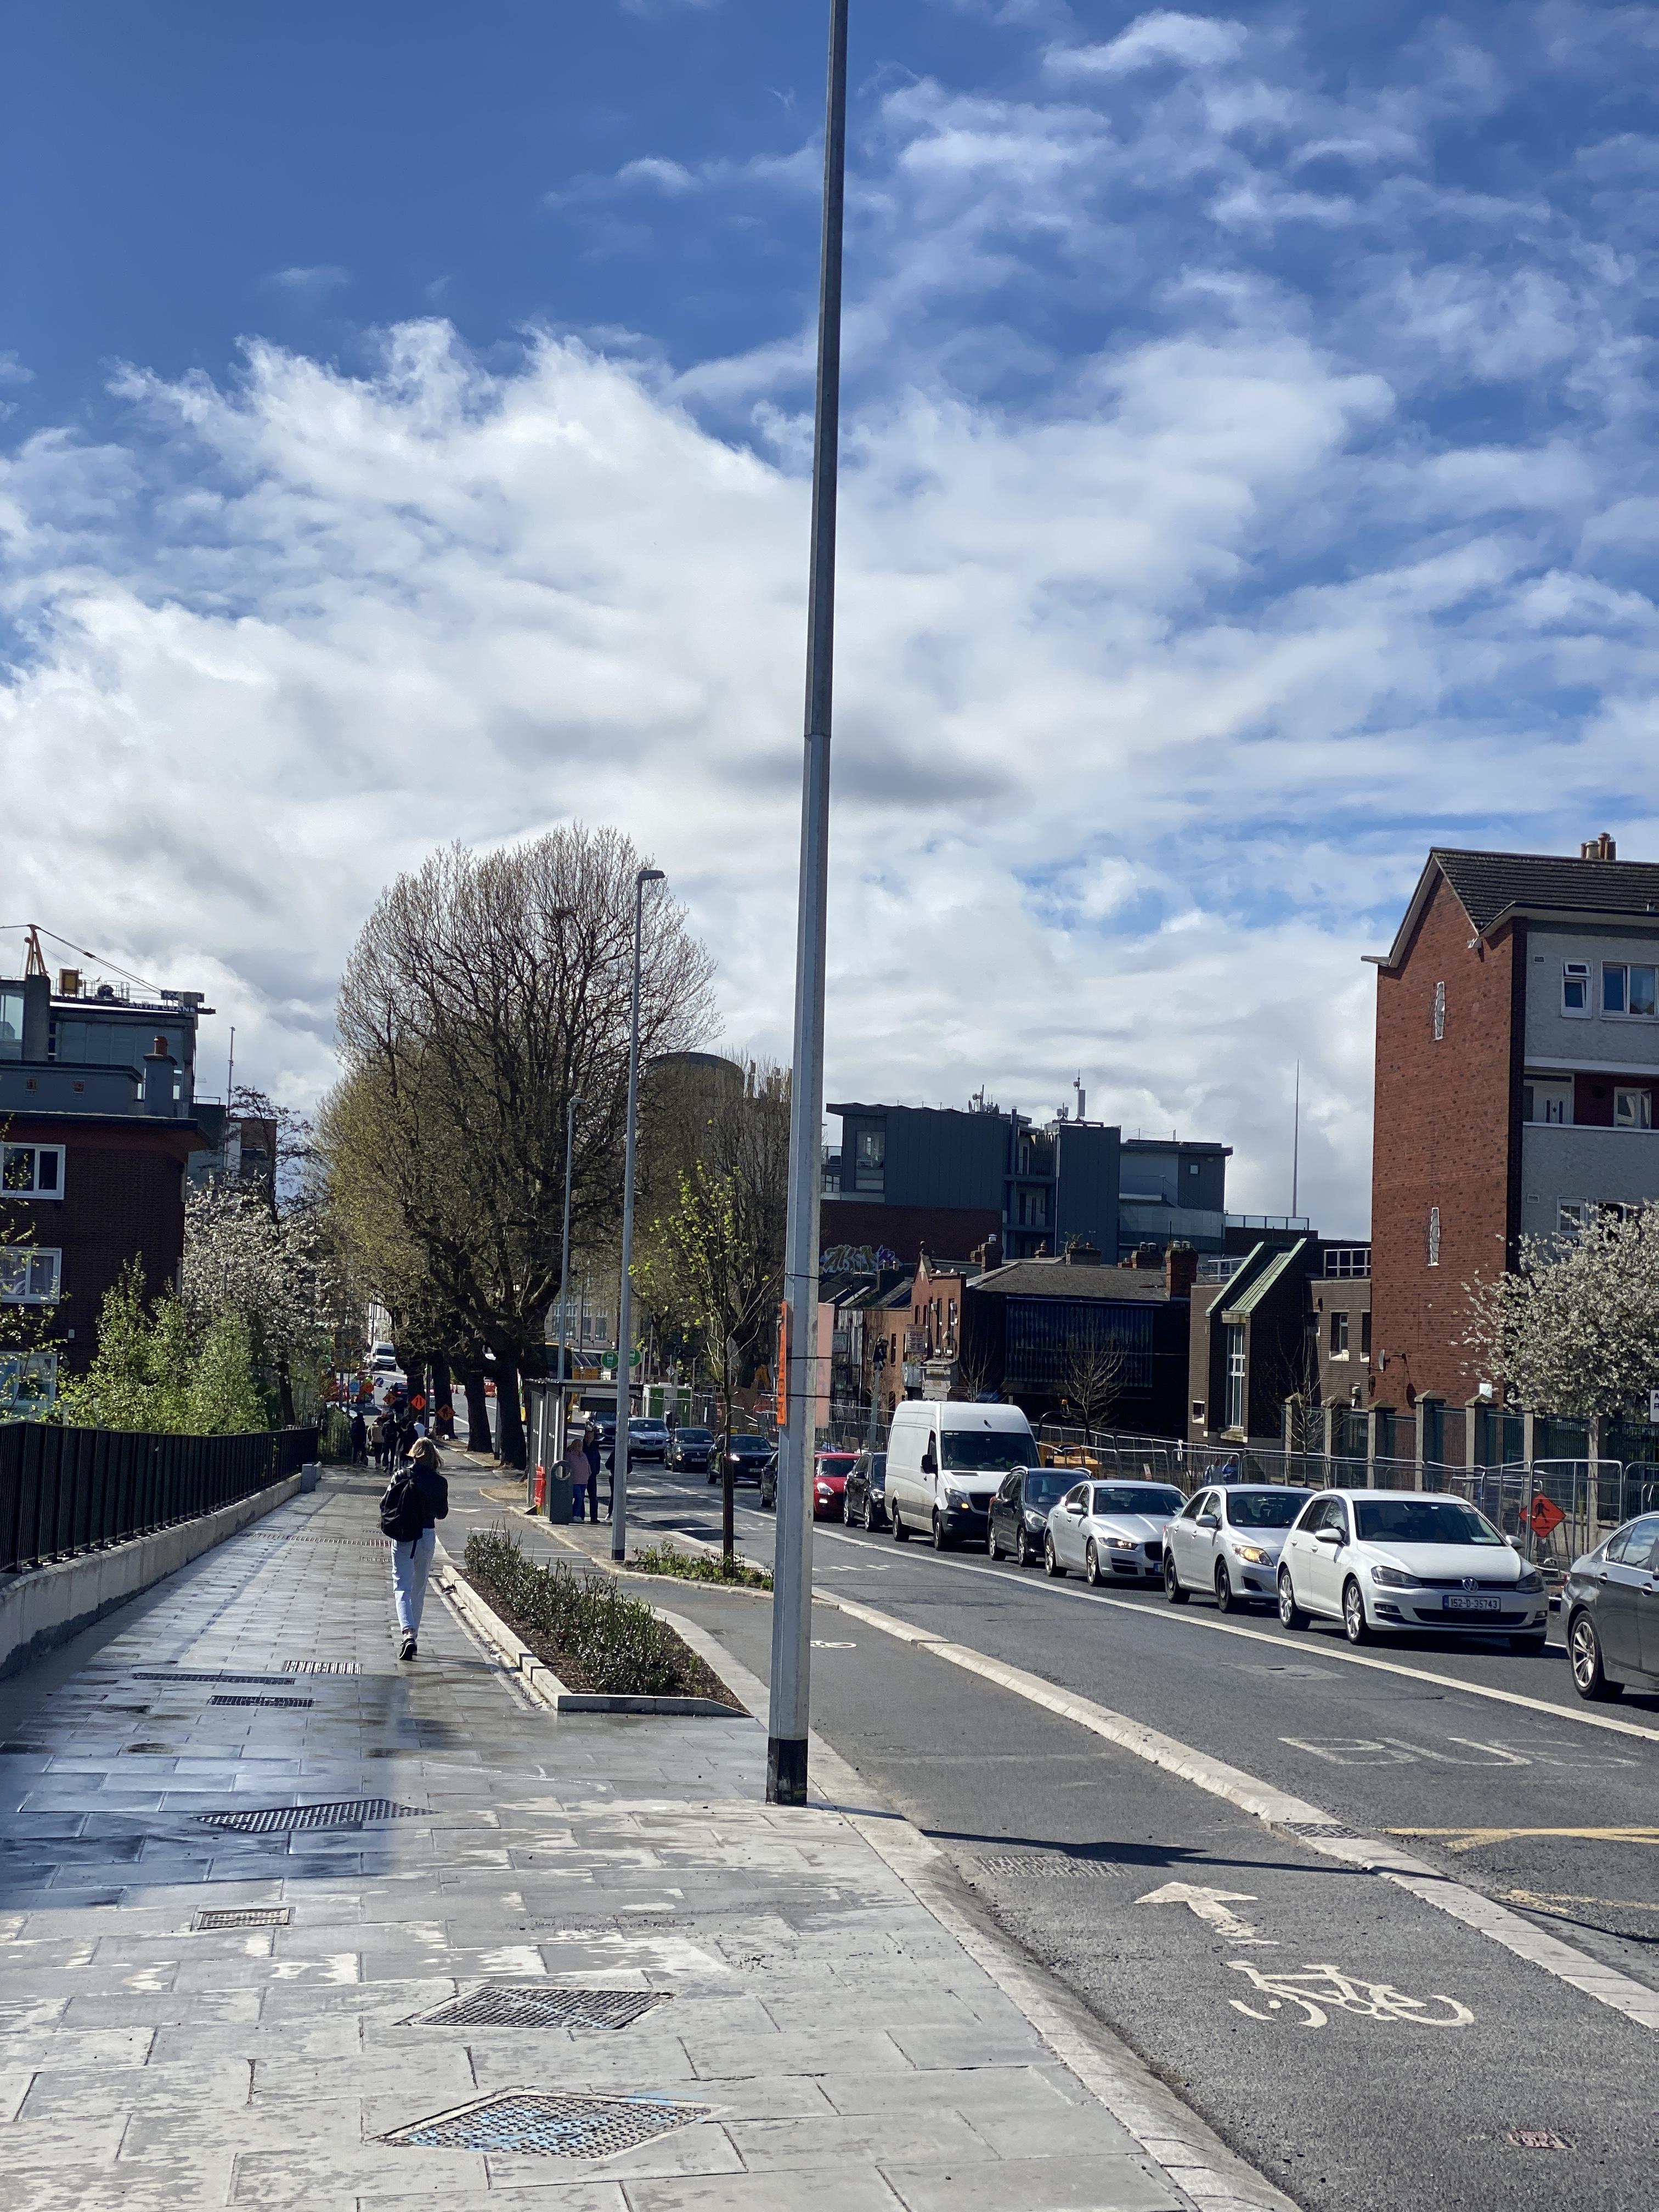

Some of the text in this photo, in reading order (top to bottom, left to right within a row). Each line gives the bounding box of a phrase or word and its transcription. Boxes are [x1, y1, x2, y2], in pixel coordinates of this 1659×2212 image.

[121, 1002, 159, 1010] MANTIS
[1451, 1598, 1497, 1609] 152-D-35743
[1276, 1736, 1641, 1768] BUS
